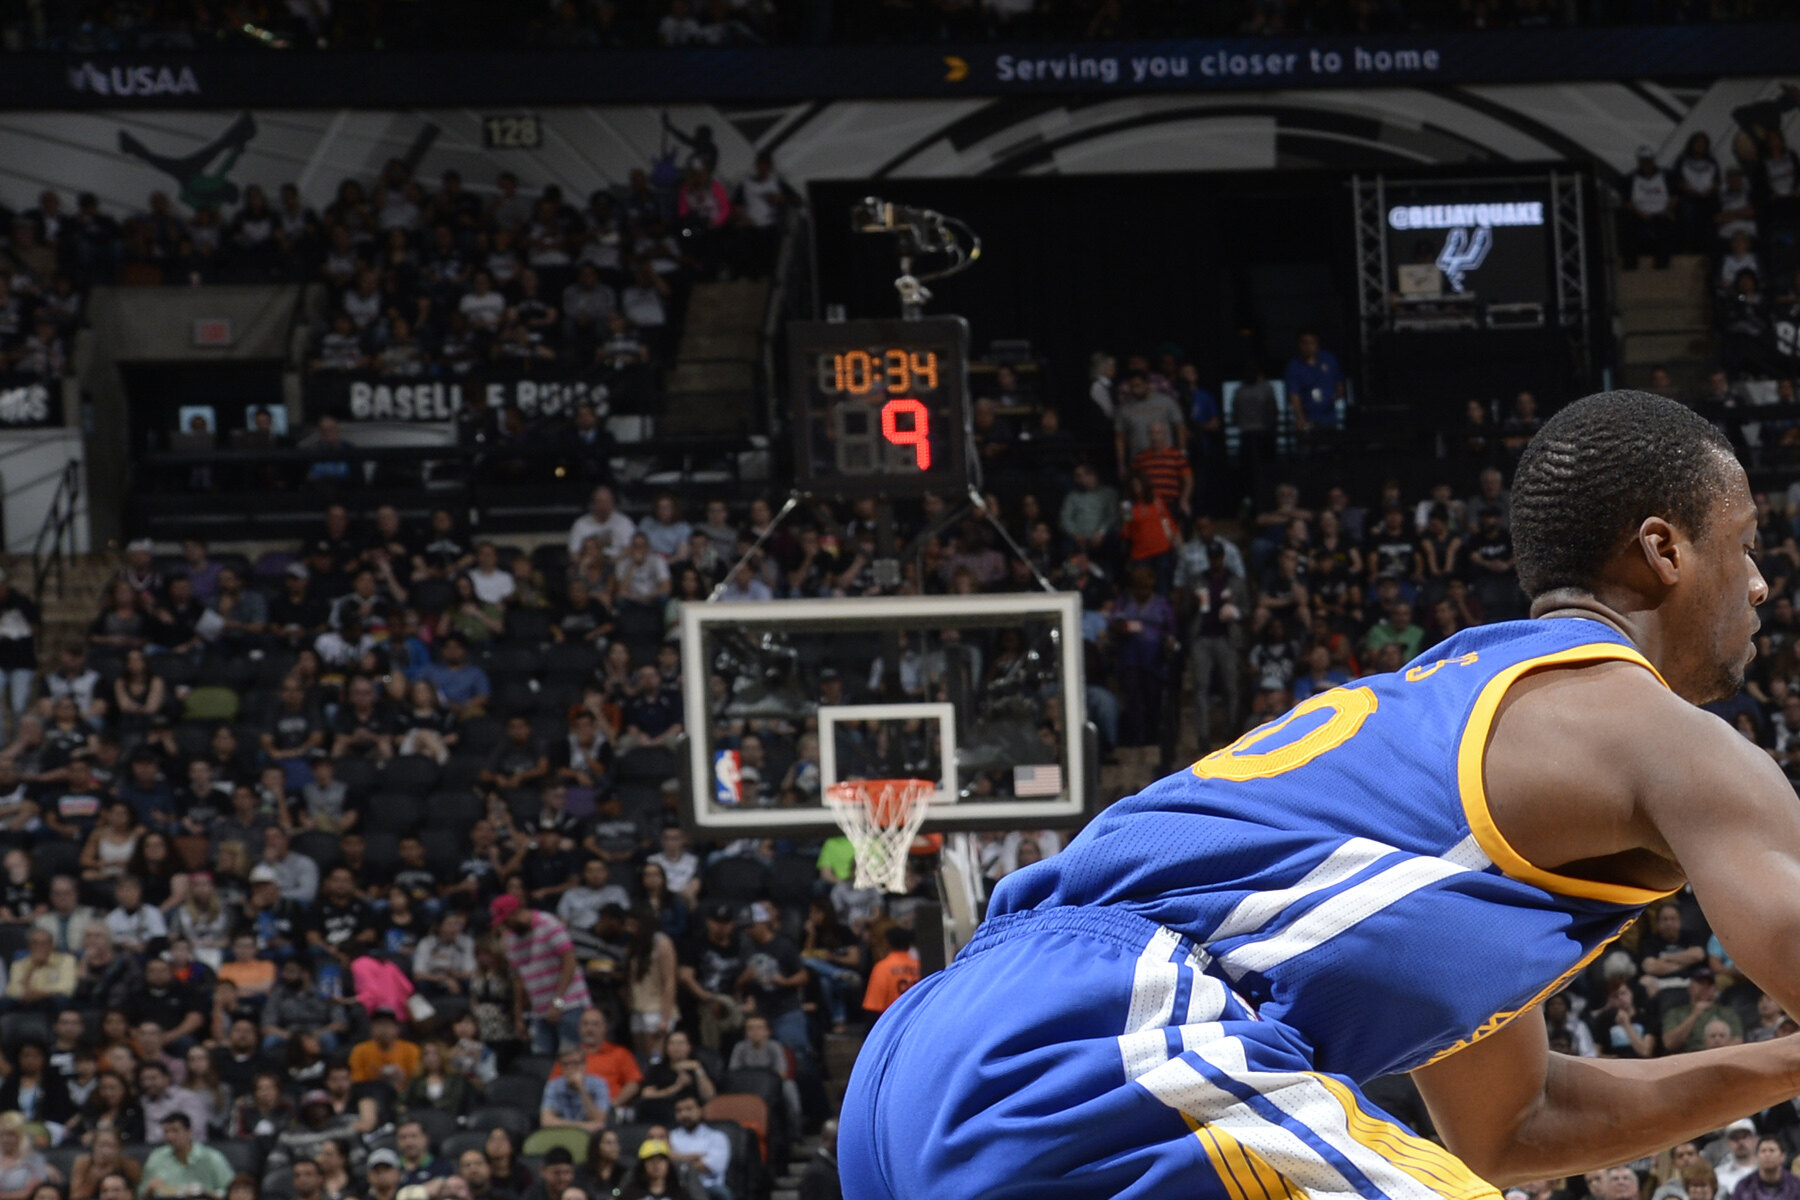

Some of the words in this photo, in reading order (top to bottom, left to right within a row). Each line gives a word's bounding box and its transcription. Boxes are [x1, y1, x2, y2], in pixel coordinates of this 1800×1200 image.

[110, 64, 202, 97] USAA
[996, 53, 1119, 84] Serving
[1131, 56, 1189, 83] you
[1200, 49, 1298, 77] closer
[1309, 48, 1343, 74] to
[1354, 45, 1440, 72] home
[487, 118, 539, 146] 128
[834, 348, 939, 395] 10:34
[350, 380, 507, 421] BASELIE
[881, 398, 932, 472] 9
